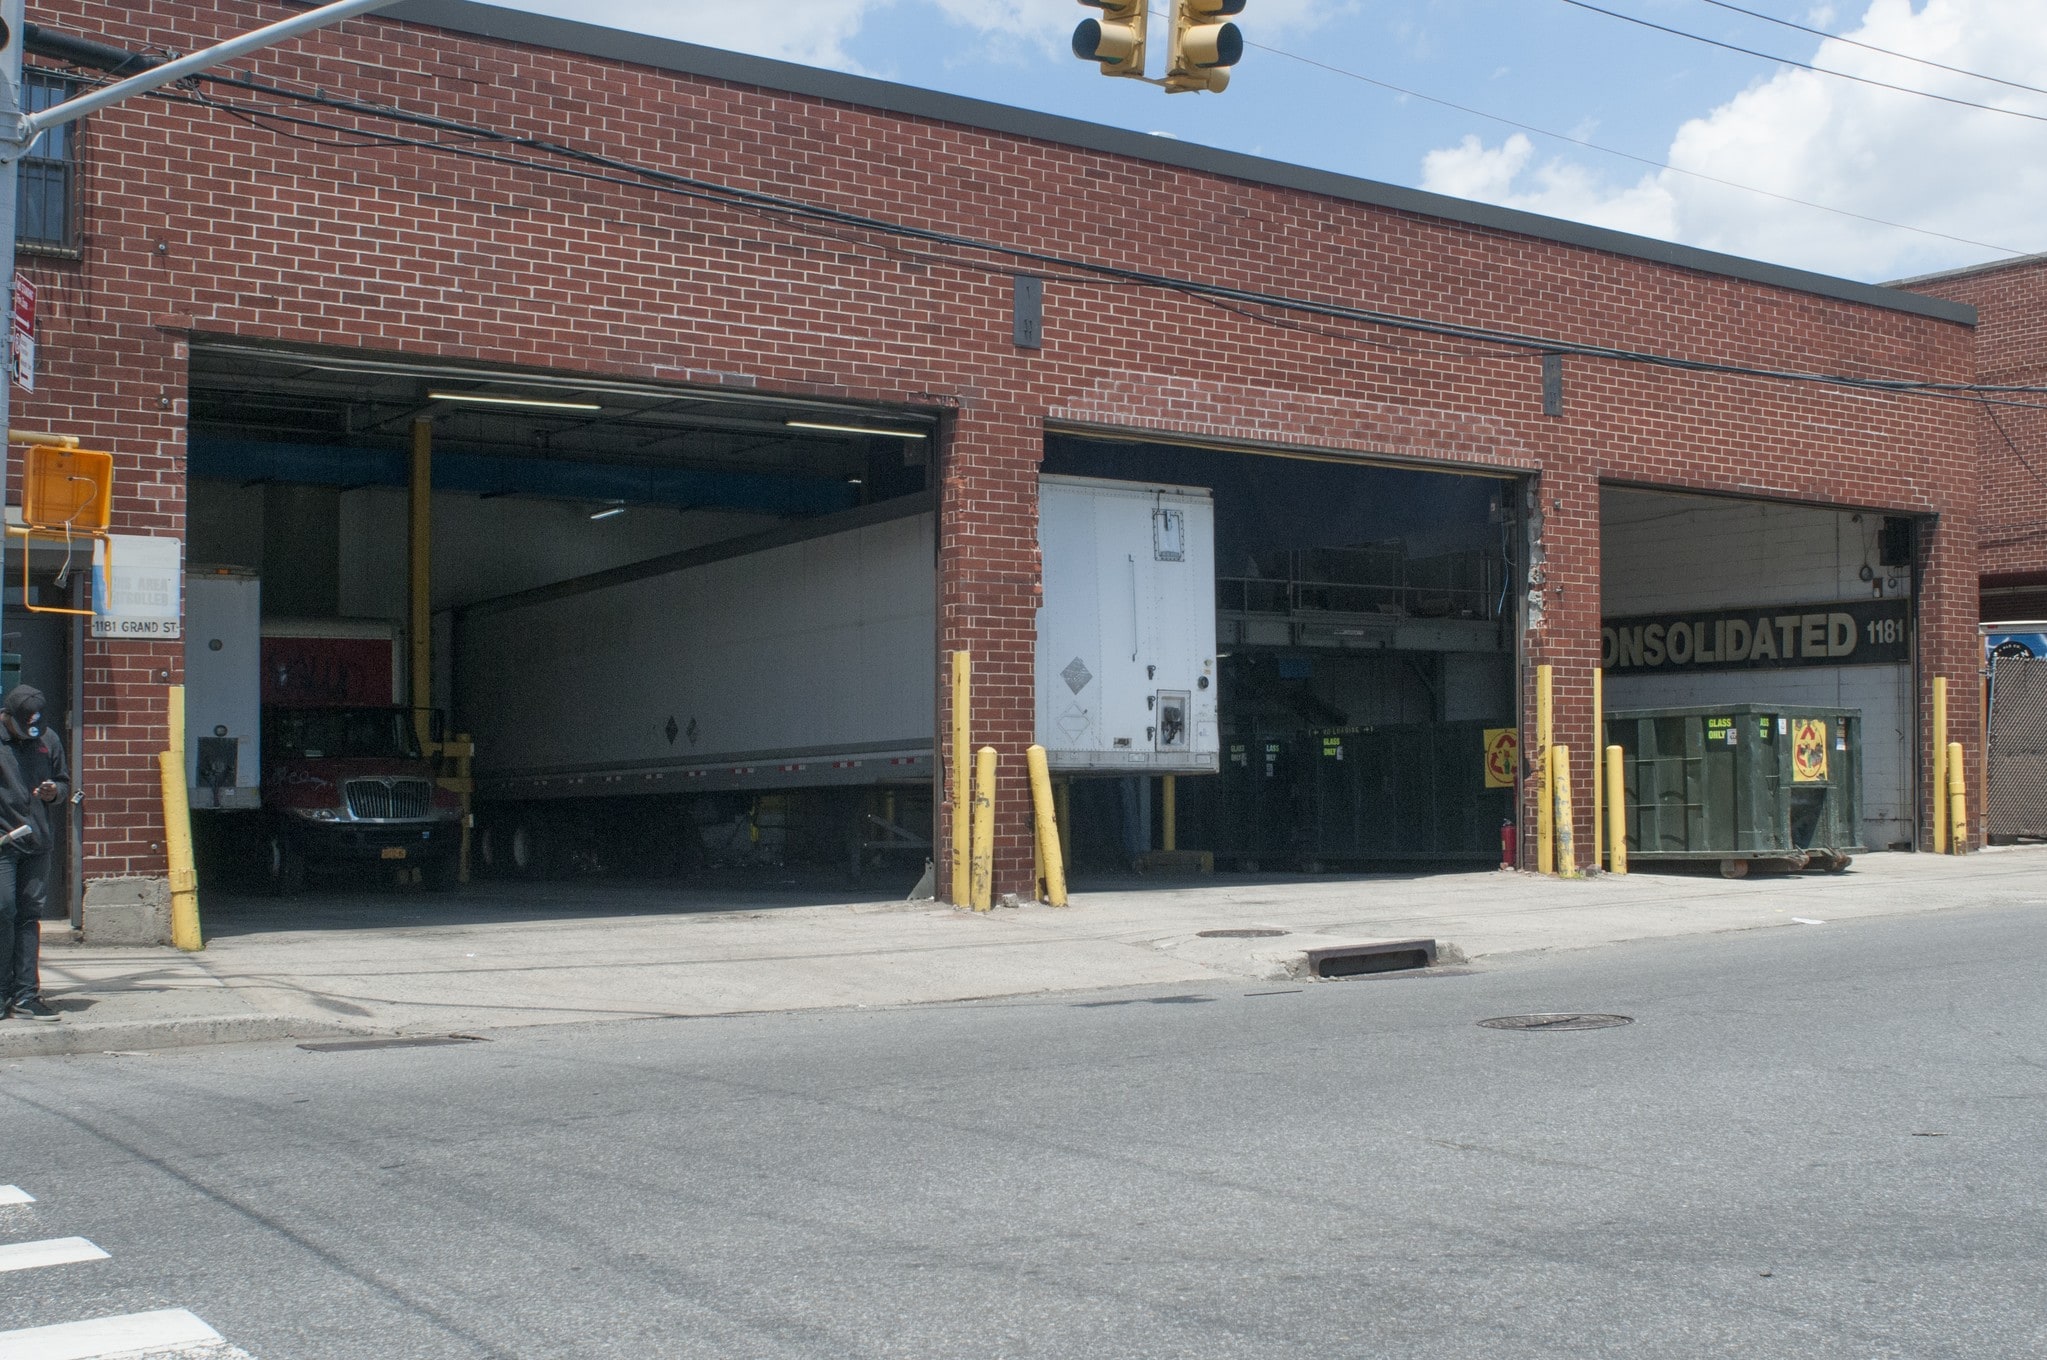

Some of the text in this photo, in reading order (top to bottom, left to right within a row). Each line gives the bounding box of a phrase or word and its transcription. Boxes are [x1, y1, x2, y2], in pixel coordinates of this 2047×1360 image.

[138, 577, 168, 592] AREA
[95, 621, 116, 632] 1181
[122, 621, 159, 633] GRAND
[1601, 612, 1904, 668] ONSOLIDATED 1181
[1708, 718, 1732, 728] GLASS
[1708, 730, 1726, 739] ONLY
